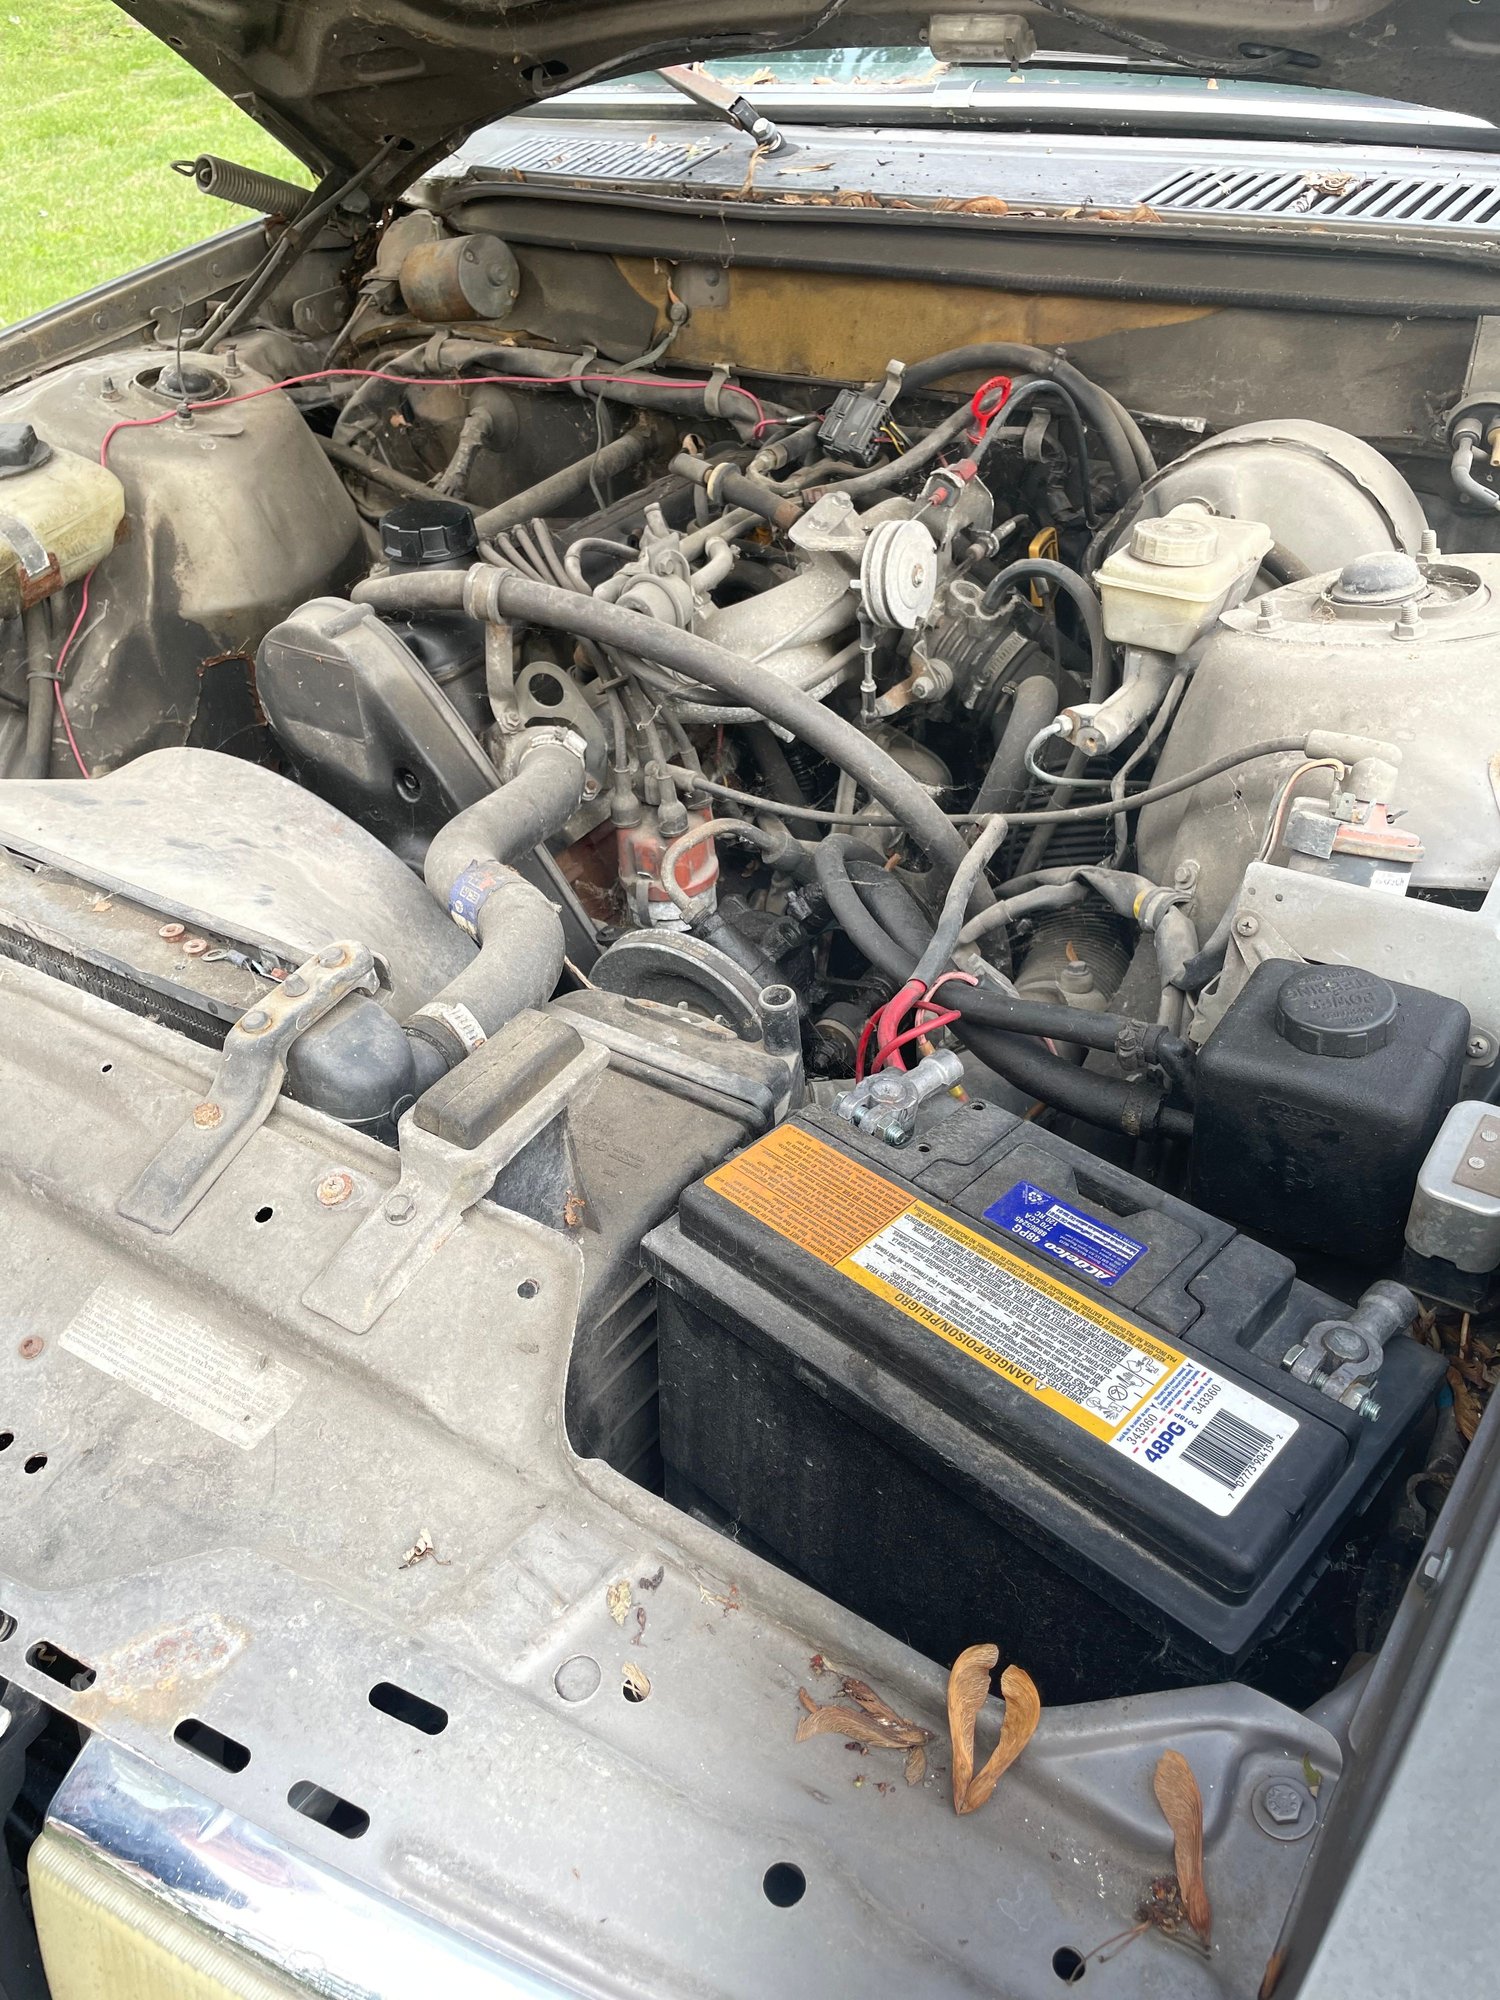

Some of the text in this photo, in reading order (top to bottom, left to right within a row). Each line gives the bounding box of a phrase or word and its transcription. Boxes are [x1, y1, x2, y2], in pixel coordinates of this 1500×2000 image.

[1024, 1212, 1052, 1231] 770 CCA
[1034, 1210, 1058, 1226] 120 RC
[923, 1225, 934, 1233] UN
[1011, 1224, 1041, 1243] 48PG
[934, 1239, 945, 1247] UN
[935, 1233, 966, 1252] INMEDIATO
[930, 1243, 951, 1258] RINCER
[922, 1256, 956, 1278] SULFURIQUE
[971, 1254, 992, 1268] LLAME
[1043, 1241, 1111, 1280] ACDelco
[950, 1266, 970, 1279] CAUSAR
[962, 1263, 978, 1274] HELP
[994, 1268, 1012, 1280] AGUA
[877, 1271, 889, 1280] LES
[926, 1276, 937, 1284] DES
[976, 1272, 1002, 1289] MEDICAL
[986, 1271, 1012, 1287] APPELER
[1010, 1277, 1024, 1287] CON
[904, 1280, 917, 1289] LOS
[1001, 1286, 1014, 1296] GET
[914, 1287, 940, 1304] PROTEJA
[946, 1288, 967, 1303] FLAMME
[1022, 1284, 1074, 1317] INMEDIATAMENTE
[1026, 1294, 1037, 1303] DE
[965, 1300, 977, 1309] UNE
[991, 1298, 1010, 1311] SEVERE
[1035, 1299, 1052, 1312] AVEC
[936, 1308, 946, 1316] OR
[978, 1309, 1001, 1324] EXPOSER
[1033, 1306, 1051, 1318] WITH
[1050, 1309, 1068, 1321] YEUX
[943, 1313, 972, 1332] BLINDNESS
[964, 1318, 975, 1326] DES
[973, 1316, 996, 1331] CEGUERA
[998, 1321, 1012, 1331] PAS
[1015, 1313, 1043, 1331] BLINDNESS
[1065, 1318, 1078, 1327] LES
[1071, 1314, 1089, 1326] OJOS
[1009, 1328, 1021, 1337] NE
[1049, 1315, 1089, 1341] IMMEDIATELY
[1087, 1323, 1101, 1333] LOS
[1109, 1327, 1127, 1339] REACH
[892, 1292, 1034, 1384] DANGER/POISON/PELIGRO
[968, 1329, 987, 1341] CAUSE
[994, 1329, 1019, 1346] PRODUCIR
[1041, 1329, 1059, 1341] CAUSE
[1098, 1330, 1133, 1352] ENJUAGUE
[1124, 1336, 1136, 1344] THE
[984, 1339, 997, 1348] CAN
[1002, 1342, 1023, 1356] CAUSER
[1034, 1335, 1056, 1350] CHISPAS
[1056, 1338, 1069, 1348] CAN
[1087, 1339, 1104, 1351] EYES
[1133, 1341, 1143, 1349] OF
[994, 1345, 1016, 1360] GASES
[1017, 1343, 1038, 1358] PUEDEN
[1054, 1348, 1072, 1360] HACER
[1067, 1345, 1084, 1357] ACID
[1080, 1345, 1092, 1354] DES
[1102, 1348, 1123, 1362] FLUSH
[1141, 1346, 1153, 1355] OUT
[1021, 1354, 1045, 1370] PEUVENT
[1049, 1353, 1071, 1367] FLAMES
[1151, 1352, 1166, 1362] KEEP
[1013, 1357, 1046, 1380] EXPLOSIVE
[1036, 1356, 1074, 1381] EXPLOSIVOS
[1076, 1361, 1096, 1375] FUMAR
[1081, 1354, 1112, 1374] SULFURIC
[1088, 1377, 1100, 1387] NO
[1093, 1372, 1105, 1381] NO
[1071, 1378, 1094, 1393] GASES
[1060, 1387, 1084, 1404] SHIELD
[1074, 1387, 1089, 1398] GAZ
[1191, 1384, 1222, 1414] 343360
[1126, 1413, 1158, 1445] 343360
[1144, 1421, 1186, 1464] 48PG
[1236, 1465, 1257, 1488] 07773
[1254, 1443, 1275, 1467] 90415
